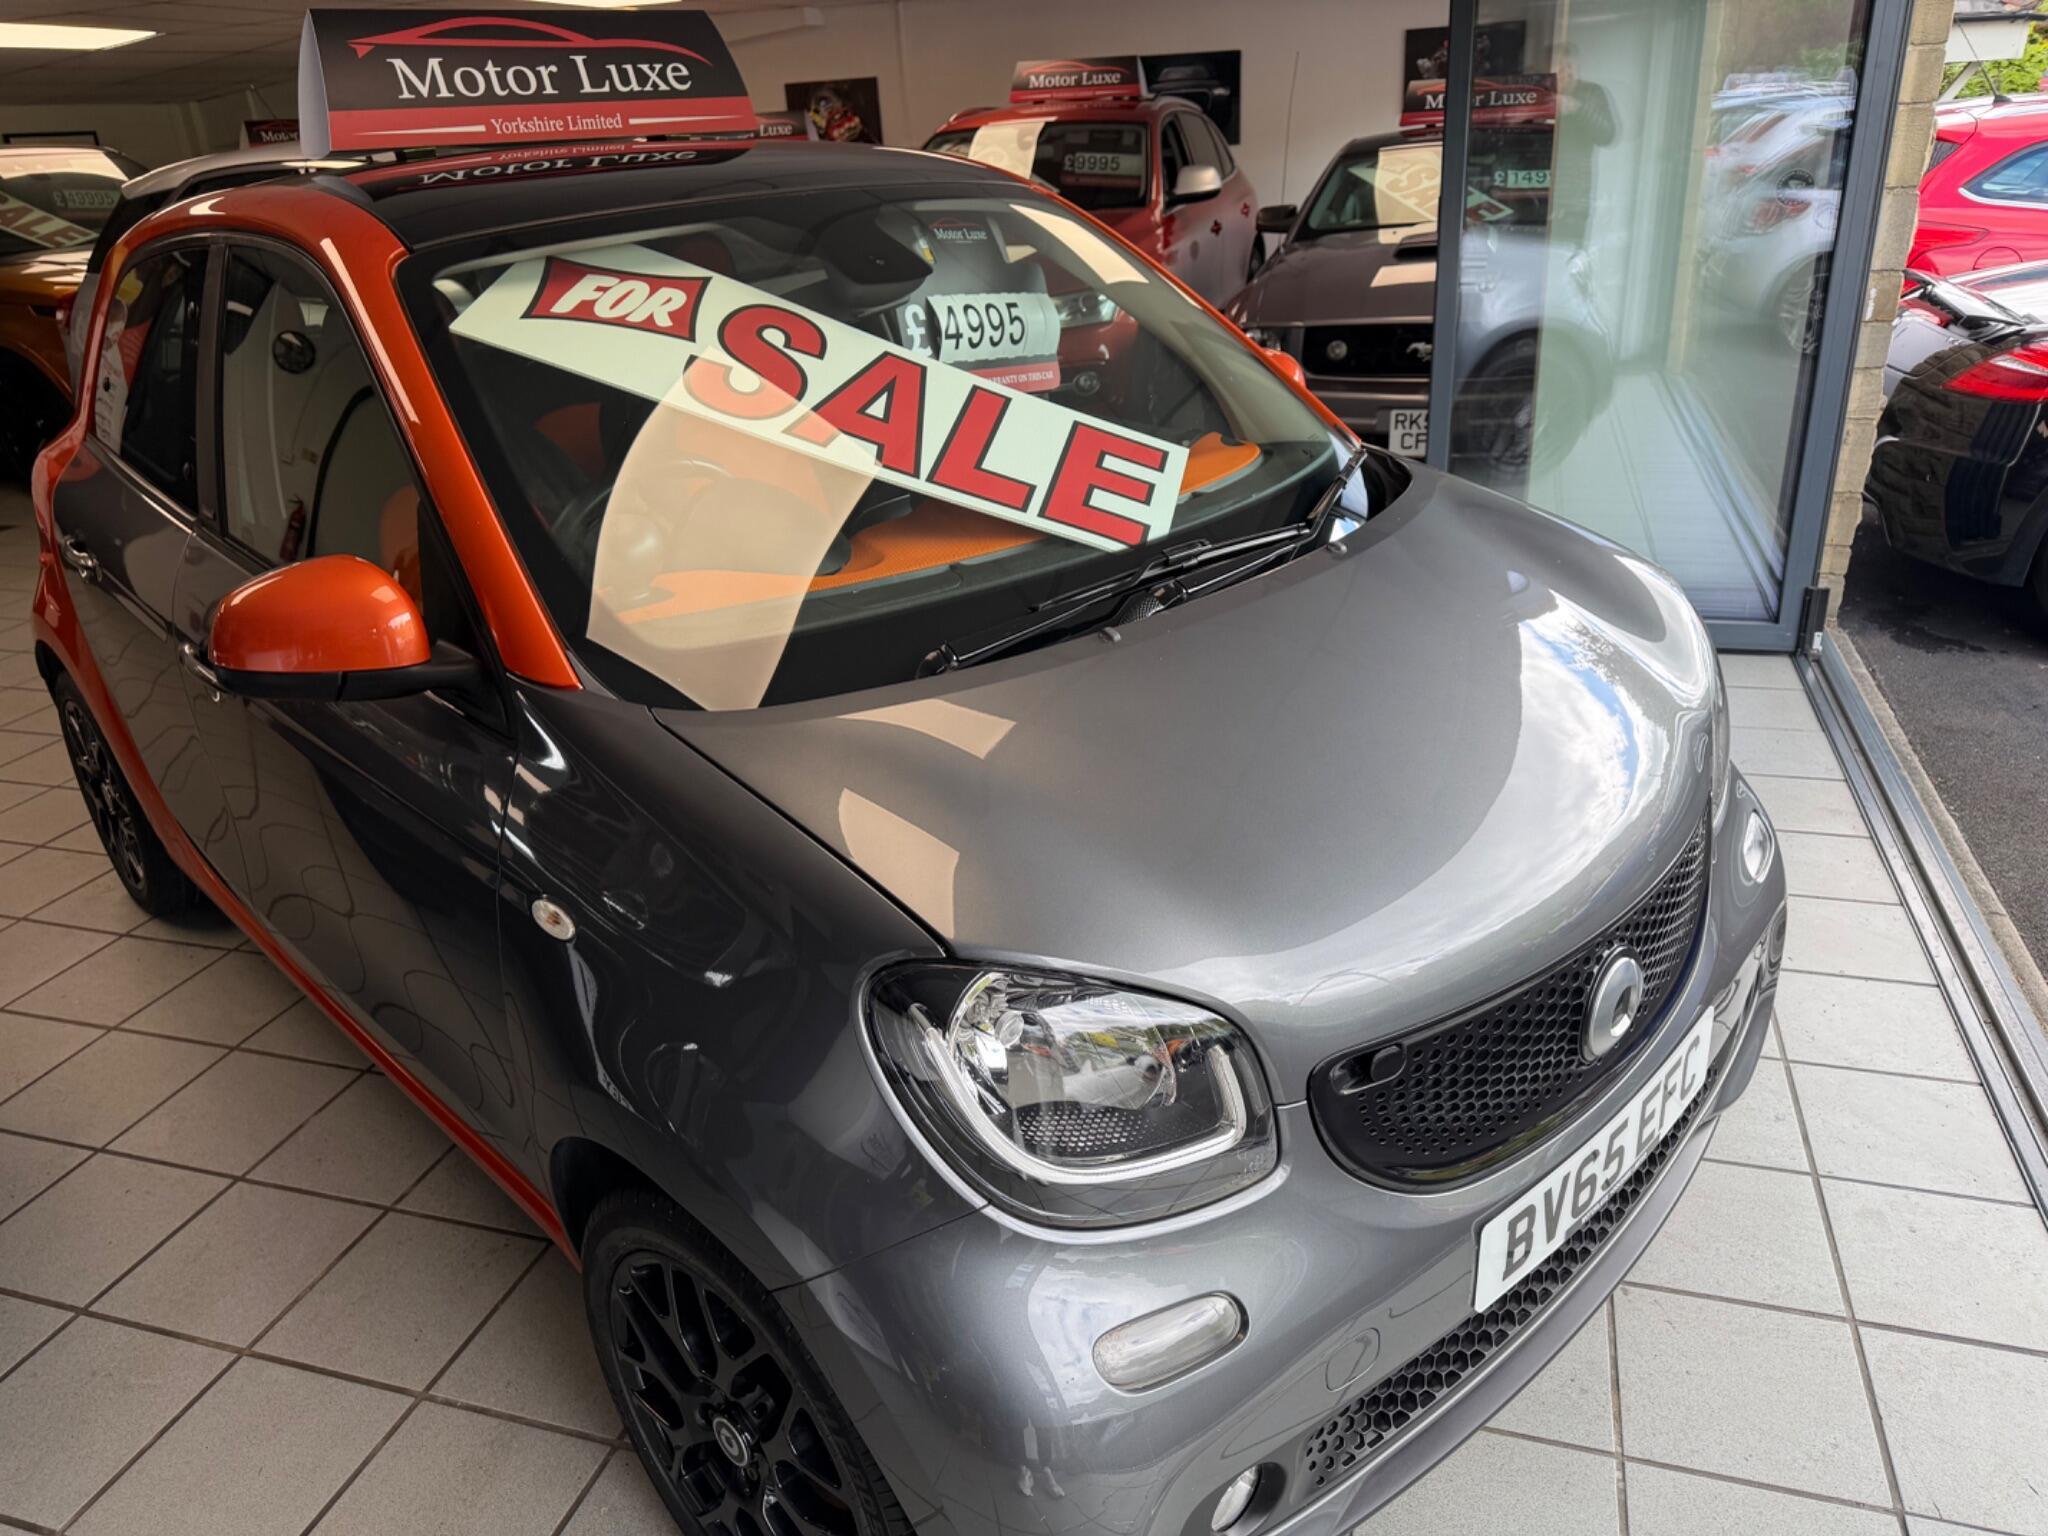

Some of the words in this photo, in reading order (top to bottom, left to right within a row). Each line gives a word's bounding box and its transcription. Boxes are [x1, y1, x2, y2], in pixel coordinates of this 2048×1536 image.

[386, 57, 559, 99] Motor
[569, 55, 692, 93] Luxe
[1029, 75, 1077, 88] Motor
[1082, 72, 1121, 85] Luxe
[1489, 91, 1537, 106] Luxe
[490, 117, 564, 134] Yorkshire
[566, 113, 623, 131] Limited
[760, 124, 792, 137] Luxe
[551, 274, 688, 327] FOR
[683, 303, 1169, 548] SALE
[1502, 1116, 1630, 1281] BV65
[1635, 1035, 1701, 1159] EFC
